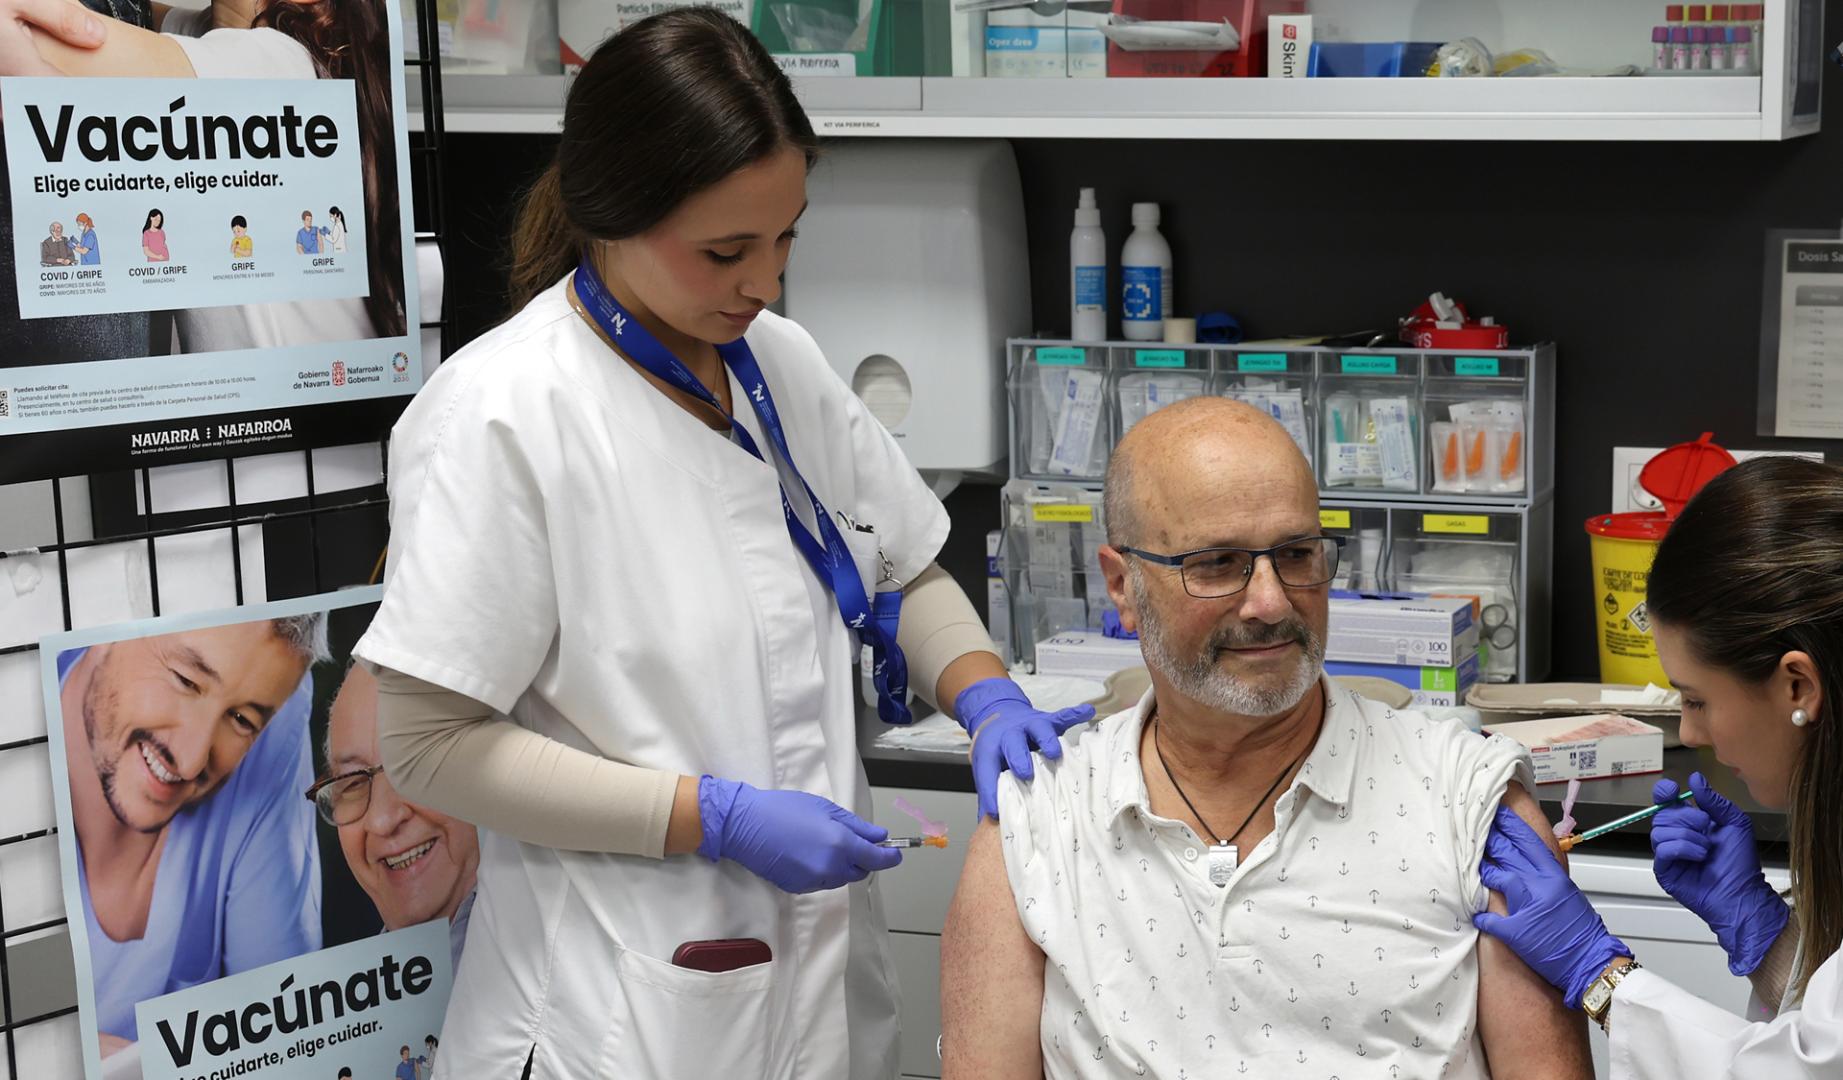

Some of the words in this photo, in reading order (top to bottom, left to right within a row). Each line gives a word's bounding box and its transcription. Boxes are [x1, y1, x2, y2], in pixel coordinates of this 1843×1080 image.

[24, 95, 338, 163] Vacúnate
[33, 174, 81, 198] Elige
[84, 172, 171, 193] cuidarte,
[174, 170, 219, 194] elige
[221, 169, 284, 188] cuidar.
[312, 258, 334, 267] GRIPE
[1798, 251, 1829, 262] Dosis
[128, 268, 156, 277] COVID
[163, 266, 187, 275] GRIPE
[231, 262, 255, 271] GRIPE
[40, 272, 69, 281] COVID
[77, 270, 102, 279] GRIPE
[298, 371, 329, 380] Gobierno
[347, 365, 384, 375] Nafarroako
[293, 382, 301, 390] de
[303, 380, 330, 388] Navarra
[347, 375, 380, 384] Gobernua
[131, 428, 200, 448] NAVARRA
[218, 418, 292, 439] NAFARROA
[1428, 641, 1447, 651] 100
[155, 954, 433, 1069] Vacúnate
[210, 1052, 284, 1080] cuidarte,
[286, 1034, 326, 1060] elige
[328, 1018, 383, 1045] cuidar.
